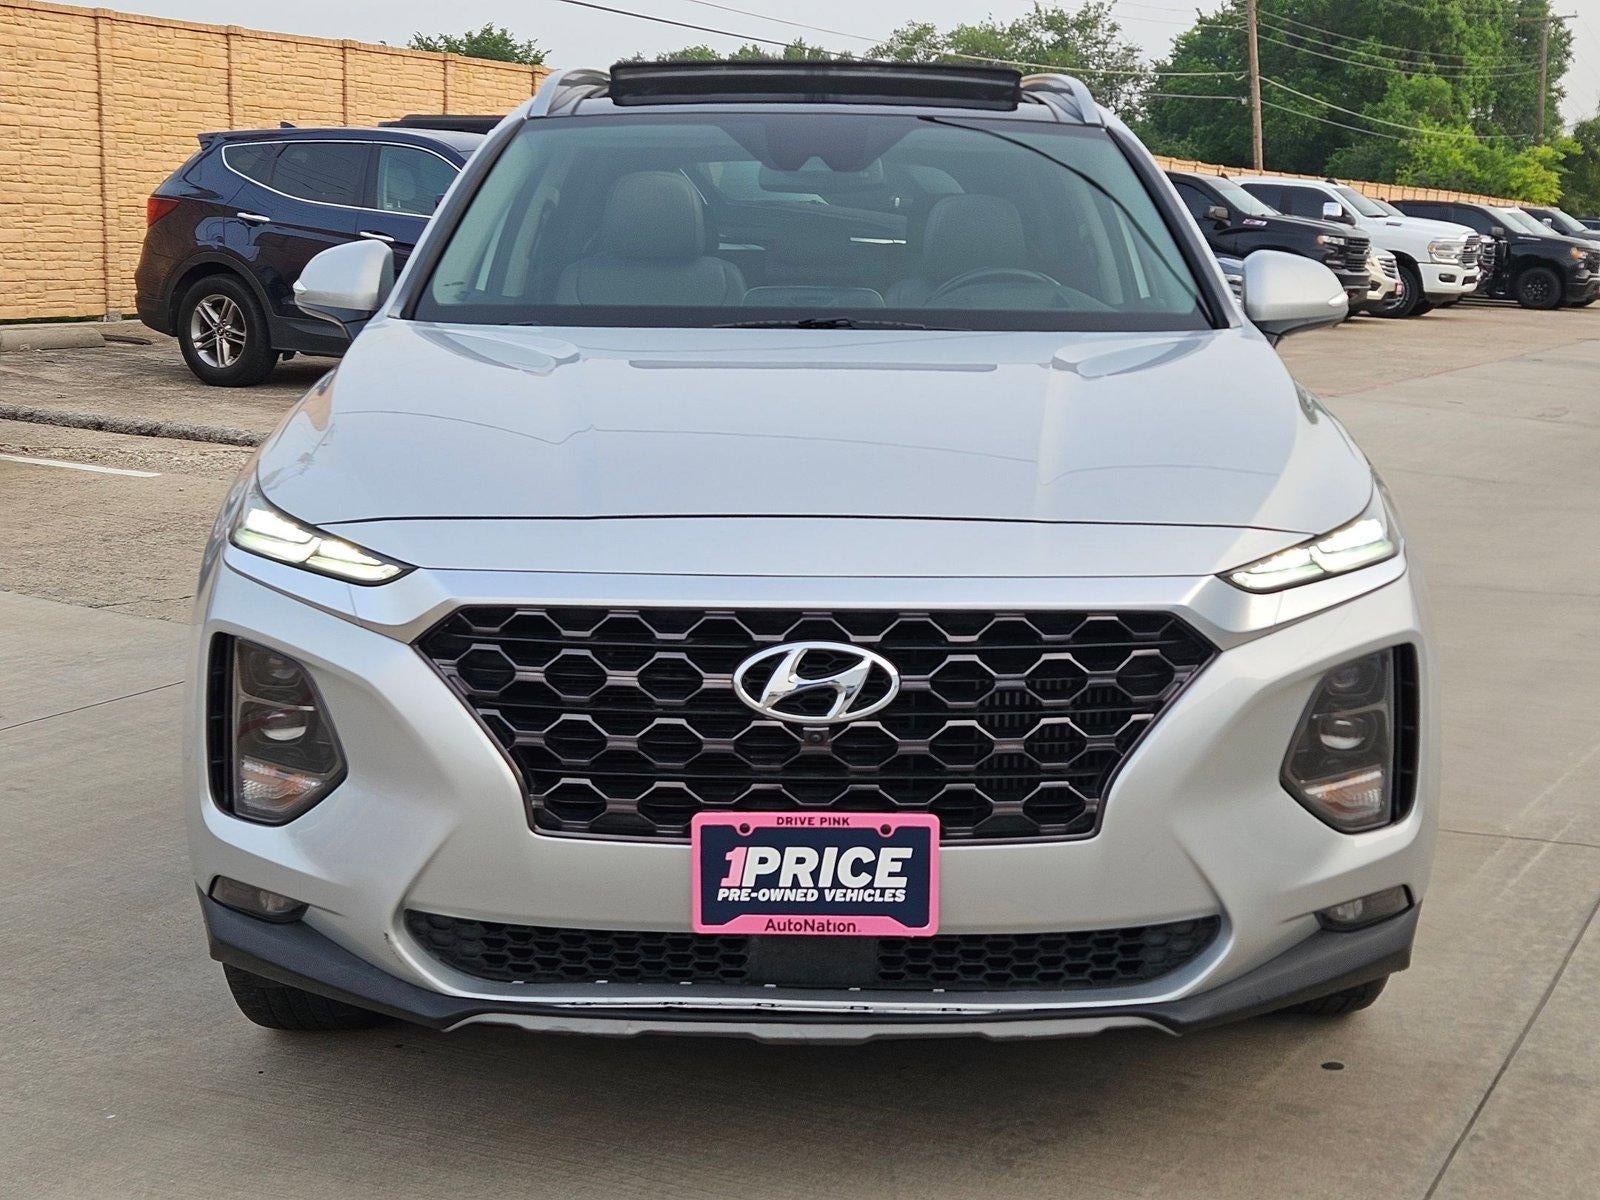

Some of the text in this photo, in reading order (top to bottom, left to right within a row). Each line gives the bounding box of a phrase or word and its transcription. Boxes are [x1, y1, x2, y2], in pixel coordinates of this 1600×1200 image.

[777, 816, 850, 826] DRIVE PINK
[717, 888, 906, 903] PRE-OWNED VEHICLES
[764, 918, 857, 933] AutoNation
